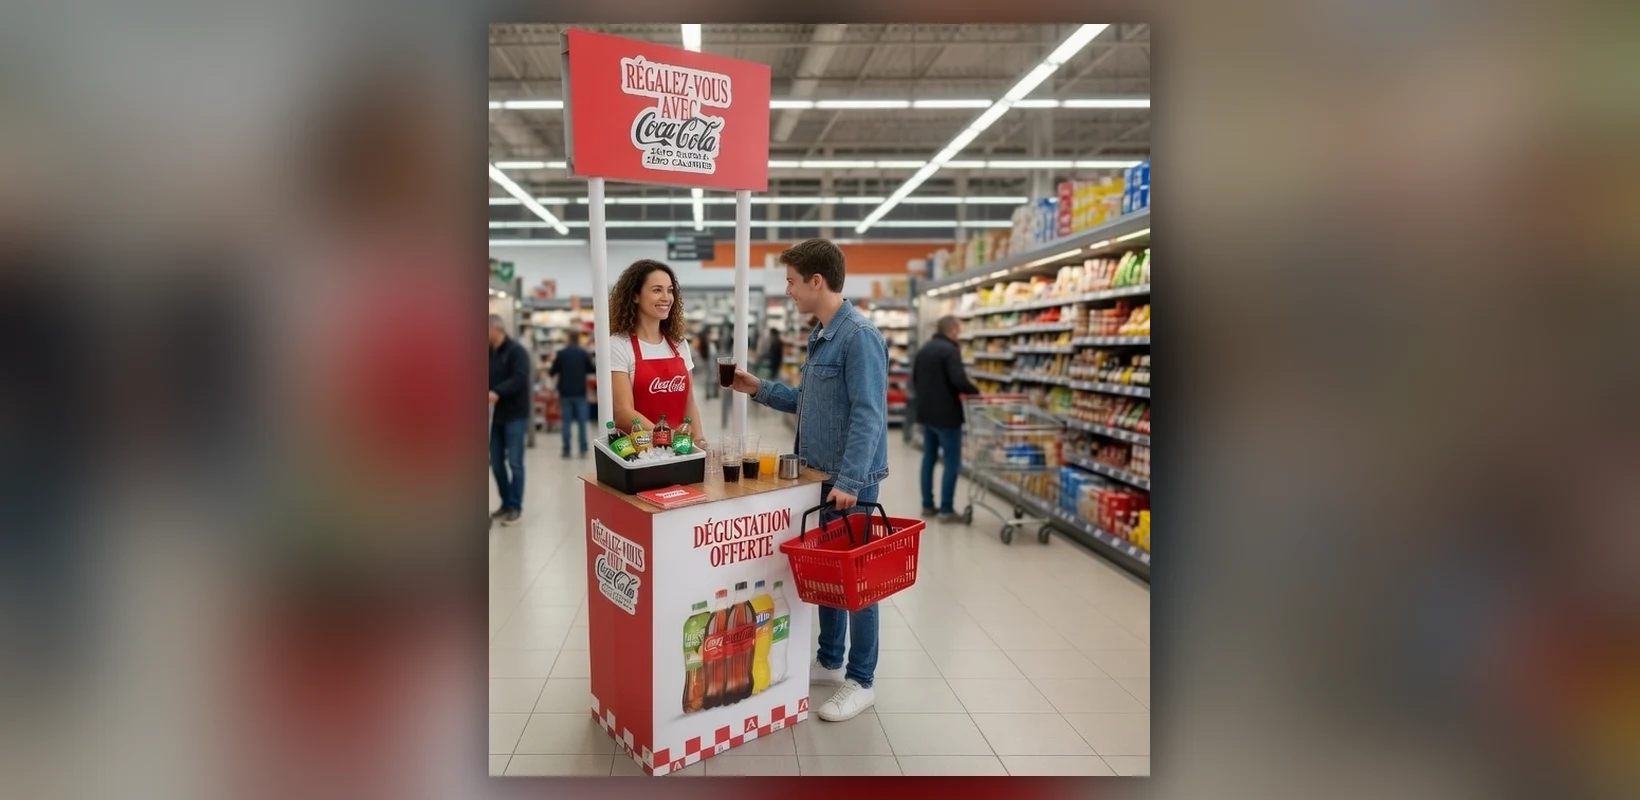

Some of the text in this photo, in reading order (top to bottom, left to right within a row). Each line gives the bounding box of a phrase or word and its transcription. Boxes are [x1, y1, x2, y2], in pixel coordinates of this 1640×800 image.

[626, 61, 728, 103] RÉGALEZ-VOUS
[661, 96, 697, 121] AVEC
[693, 508, 791, 548] DÉGUSTATION
[710, 535, 774, 567] OFFERTE
